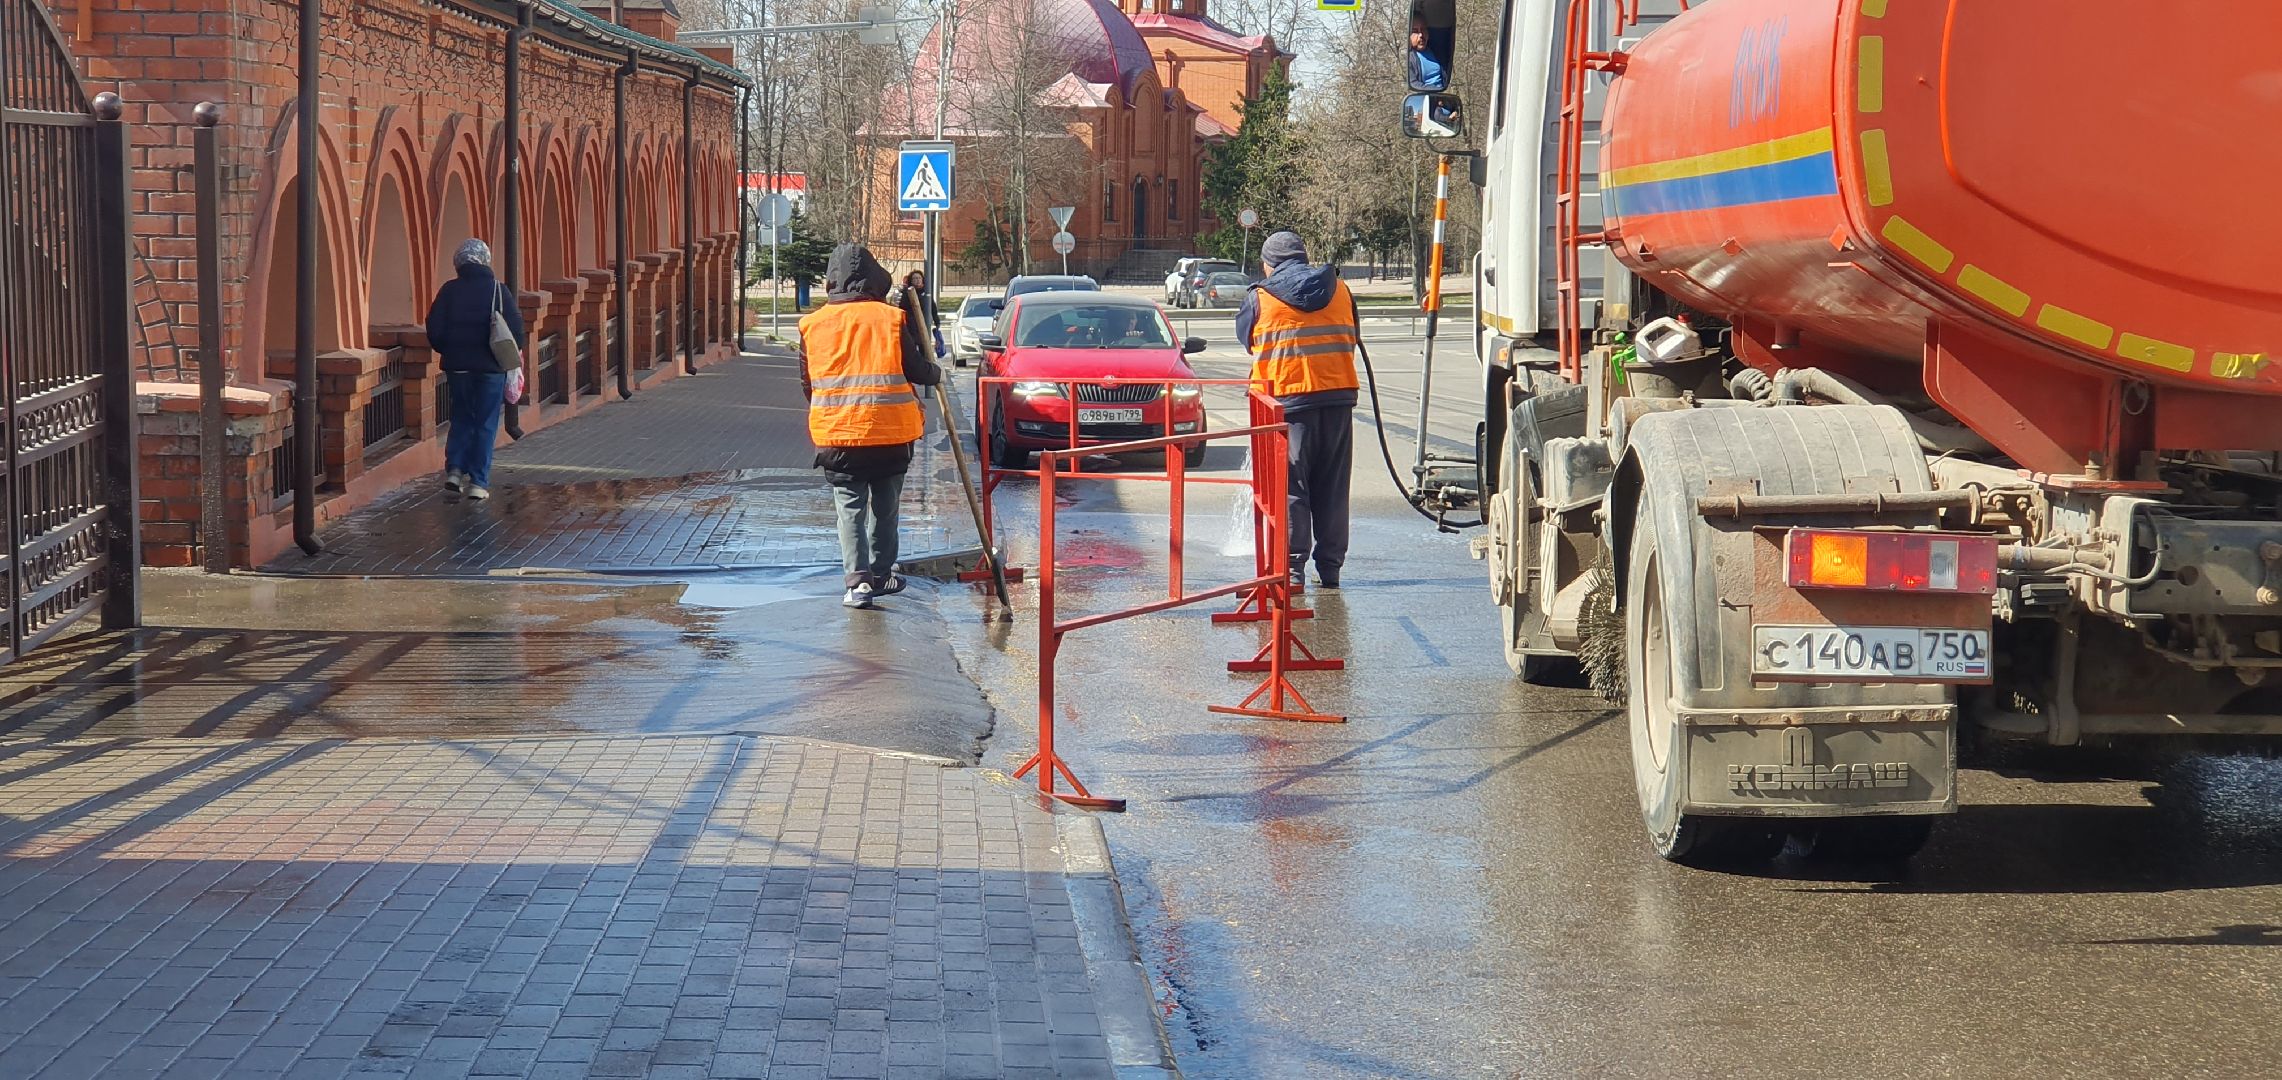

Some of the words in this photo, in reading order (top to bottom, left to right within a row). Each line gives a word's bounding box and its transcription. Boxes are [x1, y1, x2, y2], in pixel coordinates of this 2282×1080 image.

[1124, 410, 1140, 418] 799
[1767, 632, 1914, 671] С140АВ
[1923, 632, 1979, 661] 750
[1936, 661, 1964, 672] RUS
[1727, 762, 1909, 790] КОММАШ
